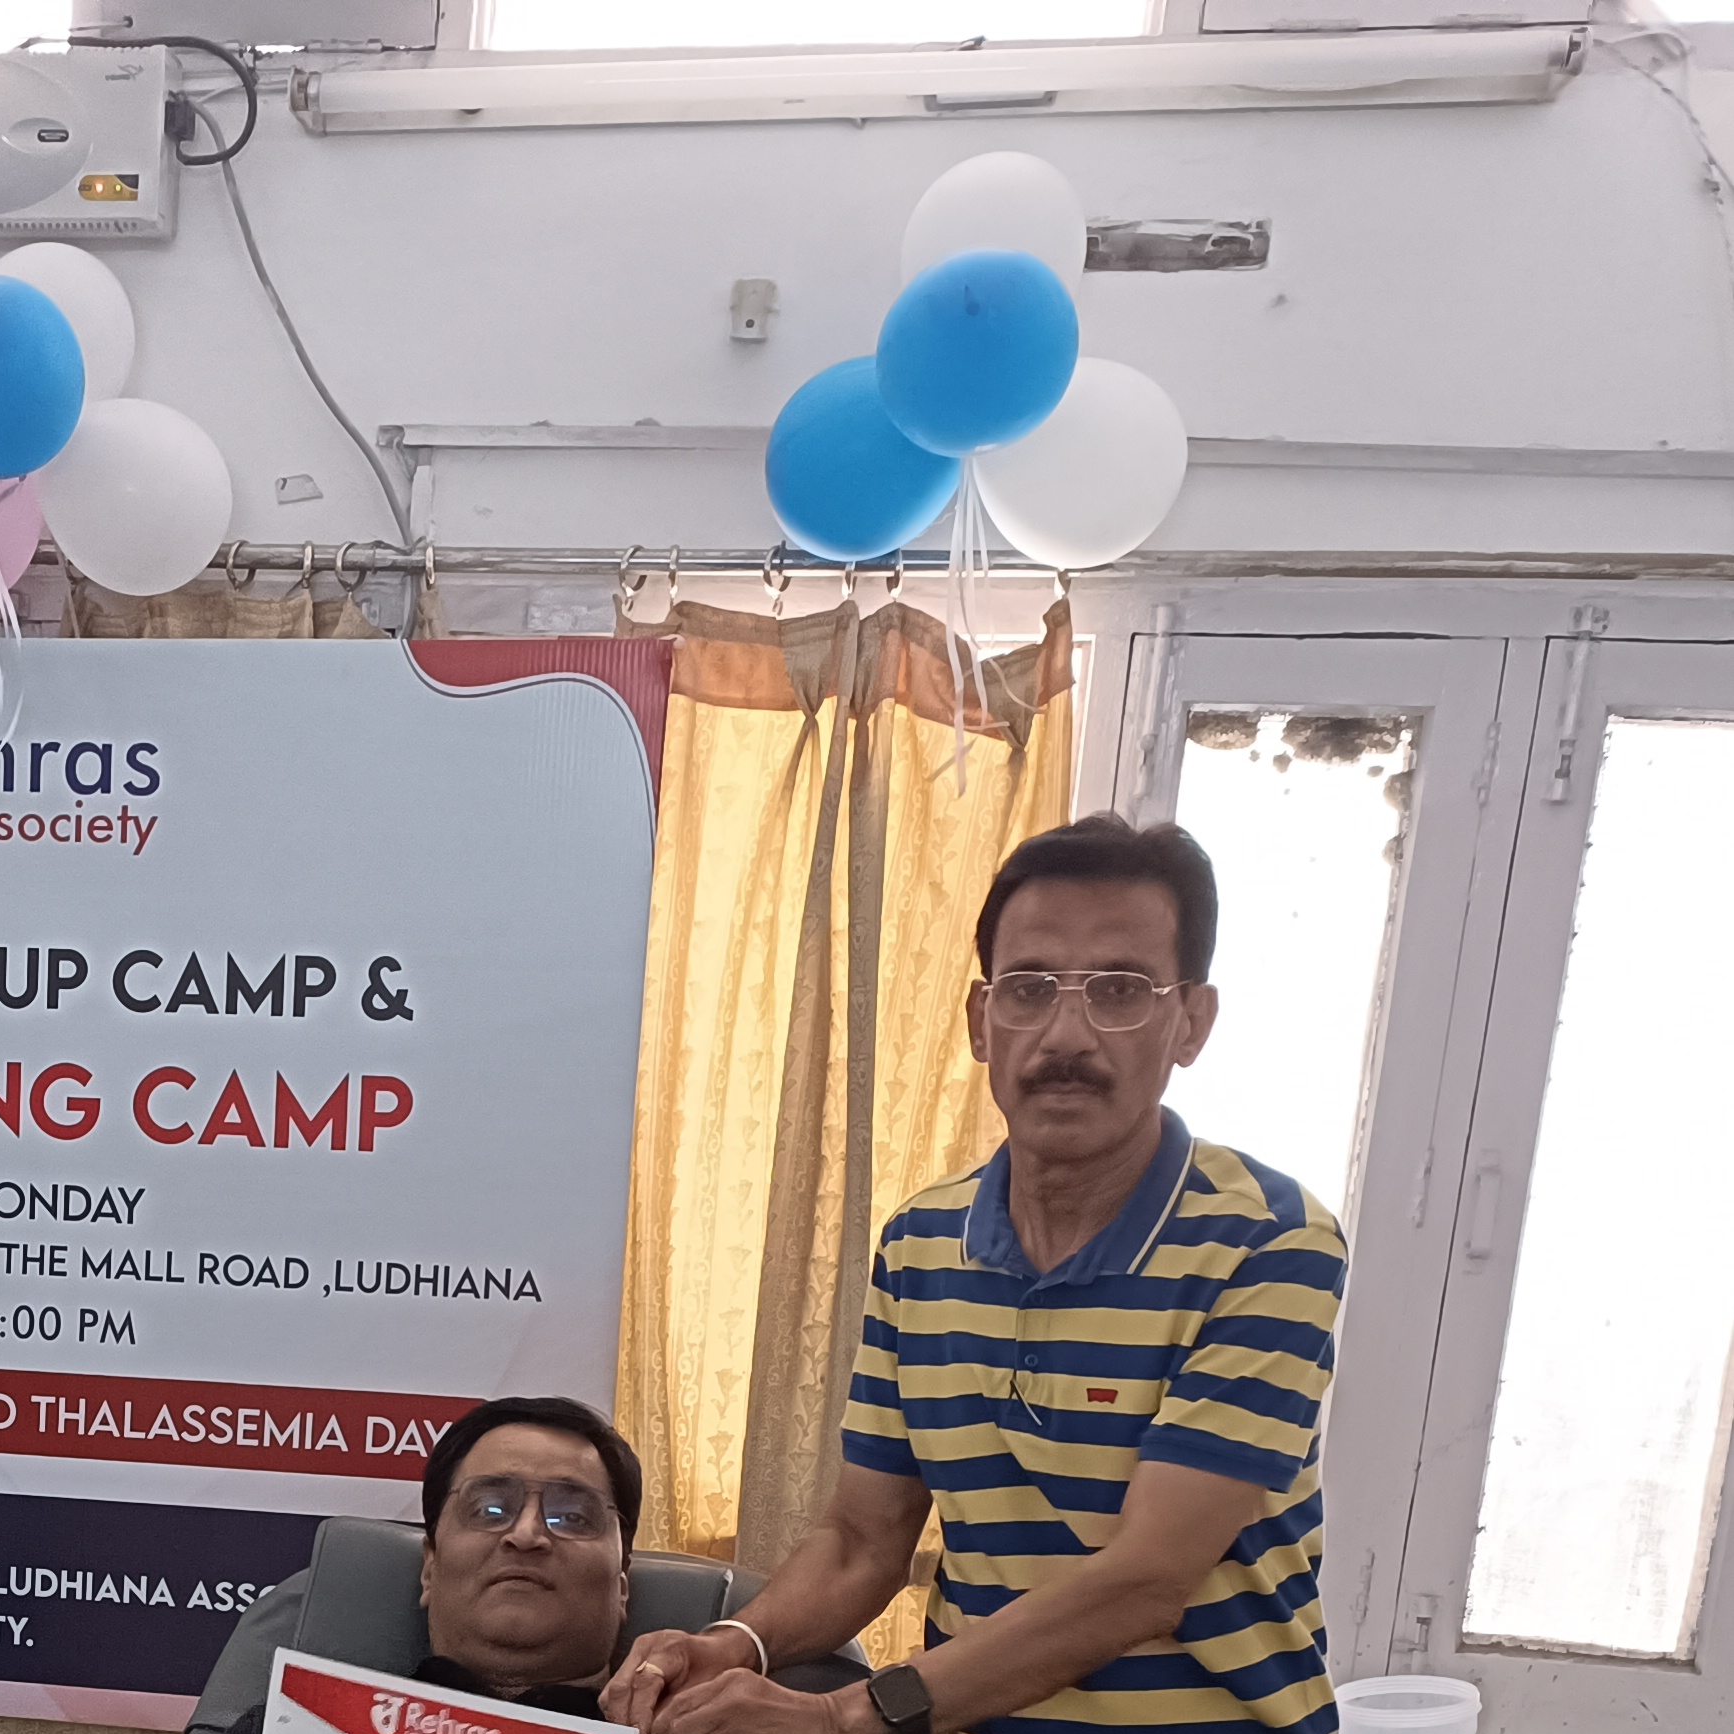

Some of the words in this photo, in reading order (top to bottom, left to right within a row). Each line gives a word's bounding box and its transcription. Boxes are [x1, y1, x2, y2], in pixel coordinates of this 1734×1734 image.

[112, 949, 337, 1018] CAMP
[361, 955, 414, 1022] &
[132, 1065, 414, 1153] CAMP
[81, 1246, 185, 1283] MALL
[198, 1252, 309, 1289] ROAD
[78, 1308, 136, 1345] PM
[30, 1395, 349, 1452] THALASSEMIA
[365, 1415, 453, 1458] DAY
[186, 1580, 277, 1613] ASS
